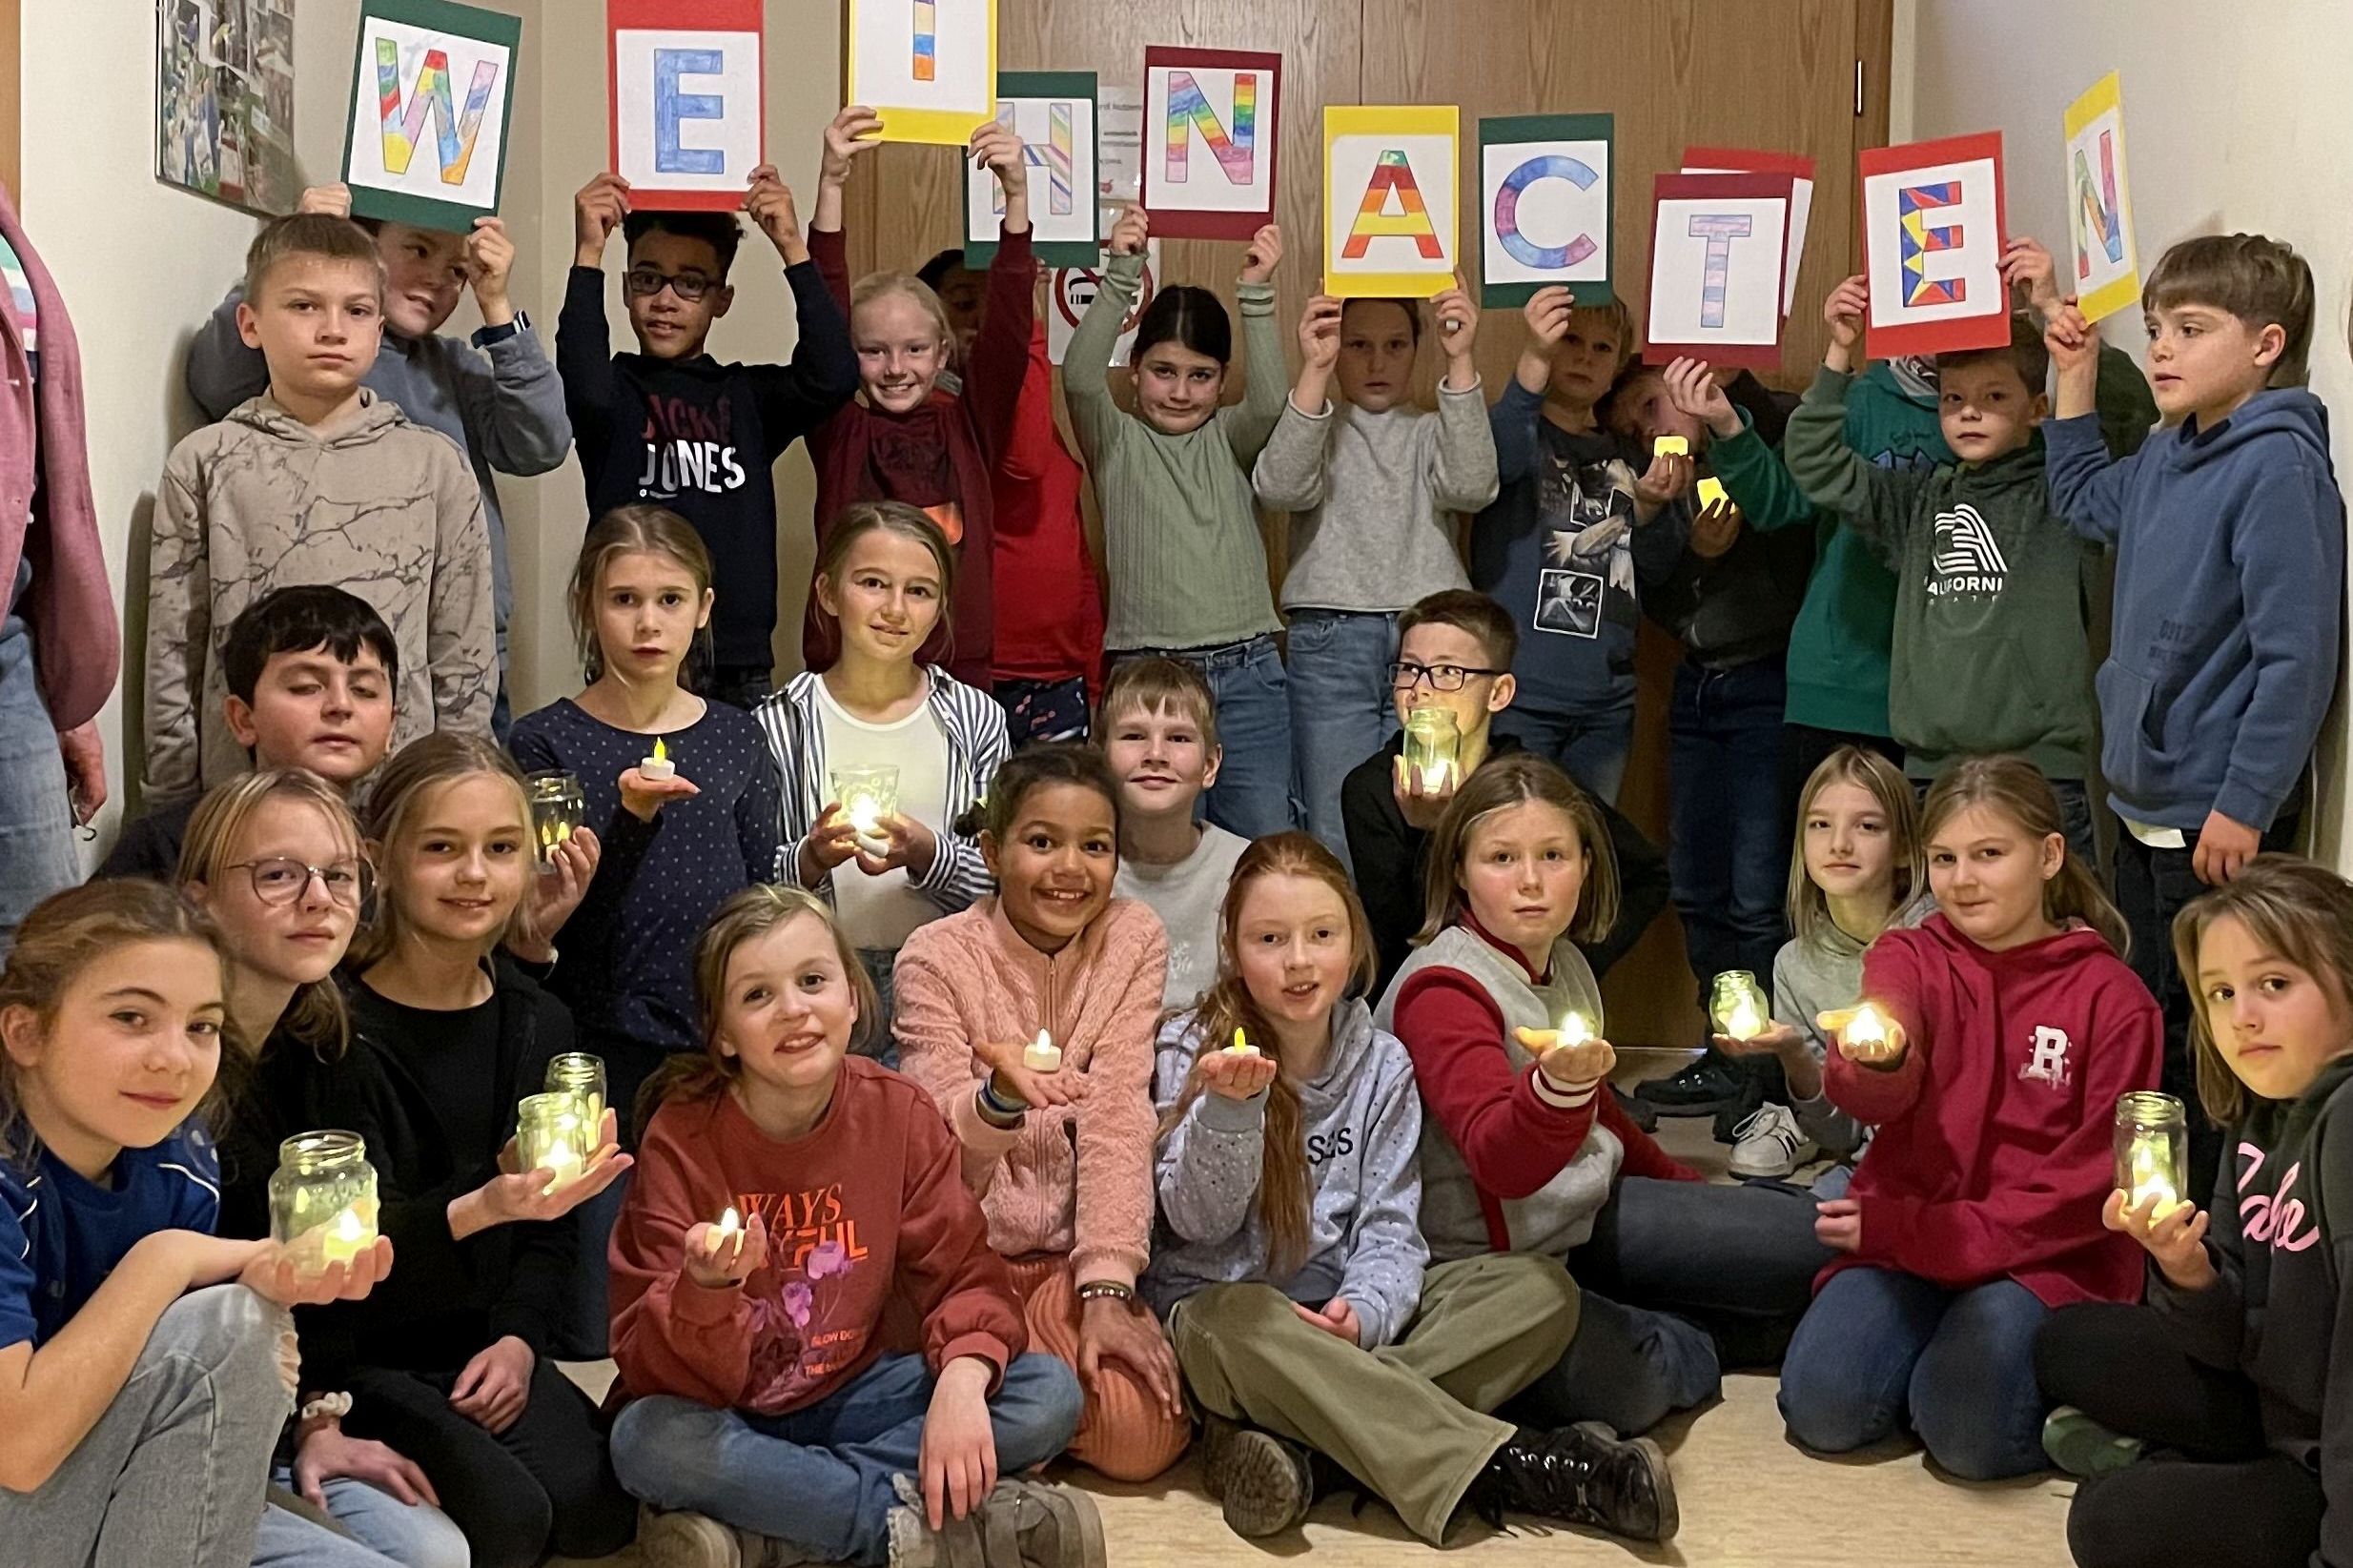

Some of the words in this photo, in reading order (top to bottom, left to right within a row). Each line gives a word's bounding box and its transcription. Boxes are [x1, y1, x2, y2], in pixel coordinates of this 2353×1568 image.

[376, 37, 498, 185] W
[654, 49, 725, 174] E
[992, 102, 1073, 215] H
[1165, 71, 1257, 185] N
[1341, 150, 1444, 259] A
[1495, 155, 1600, 270] C
[1688, 214, 1752, 329] T
[1899, 181, 1966, 308] E
[2076, 130, 2123, 279] N
[638, 439, 746, 494] JONES
